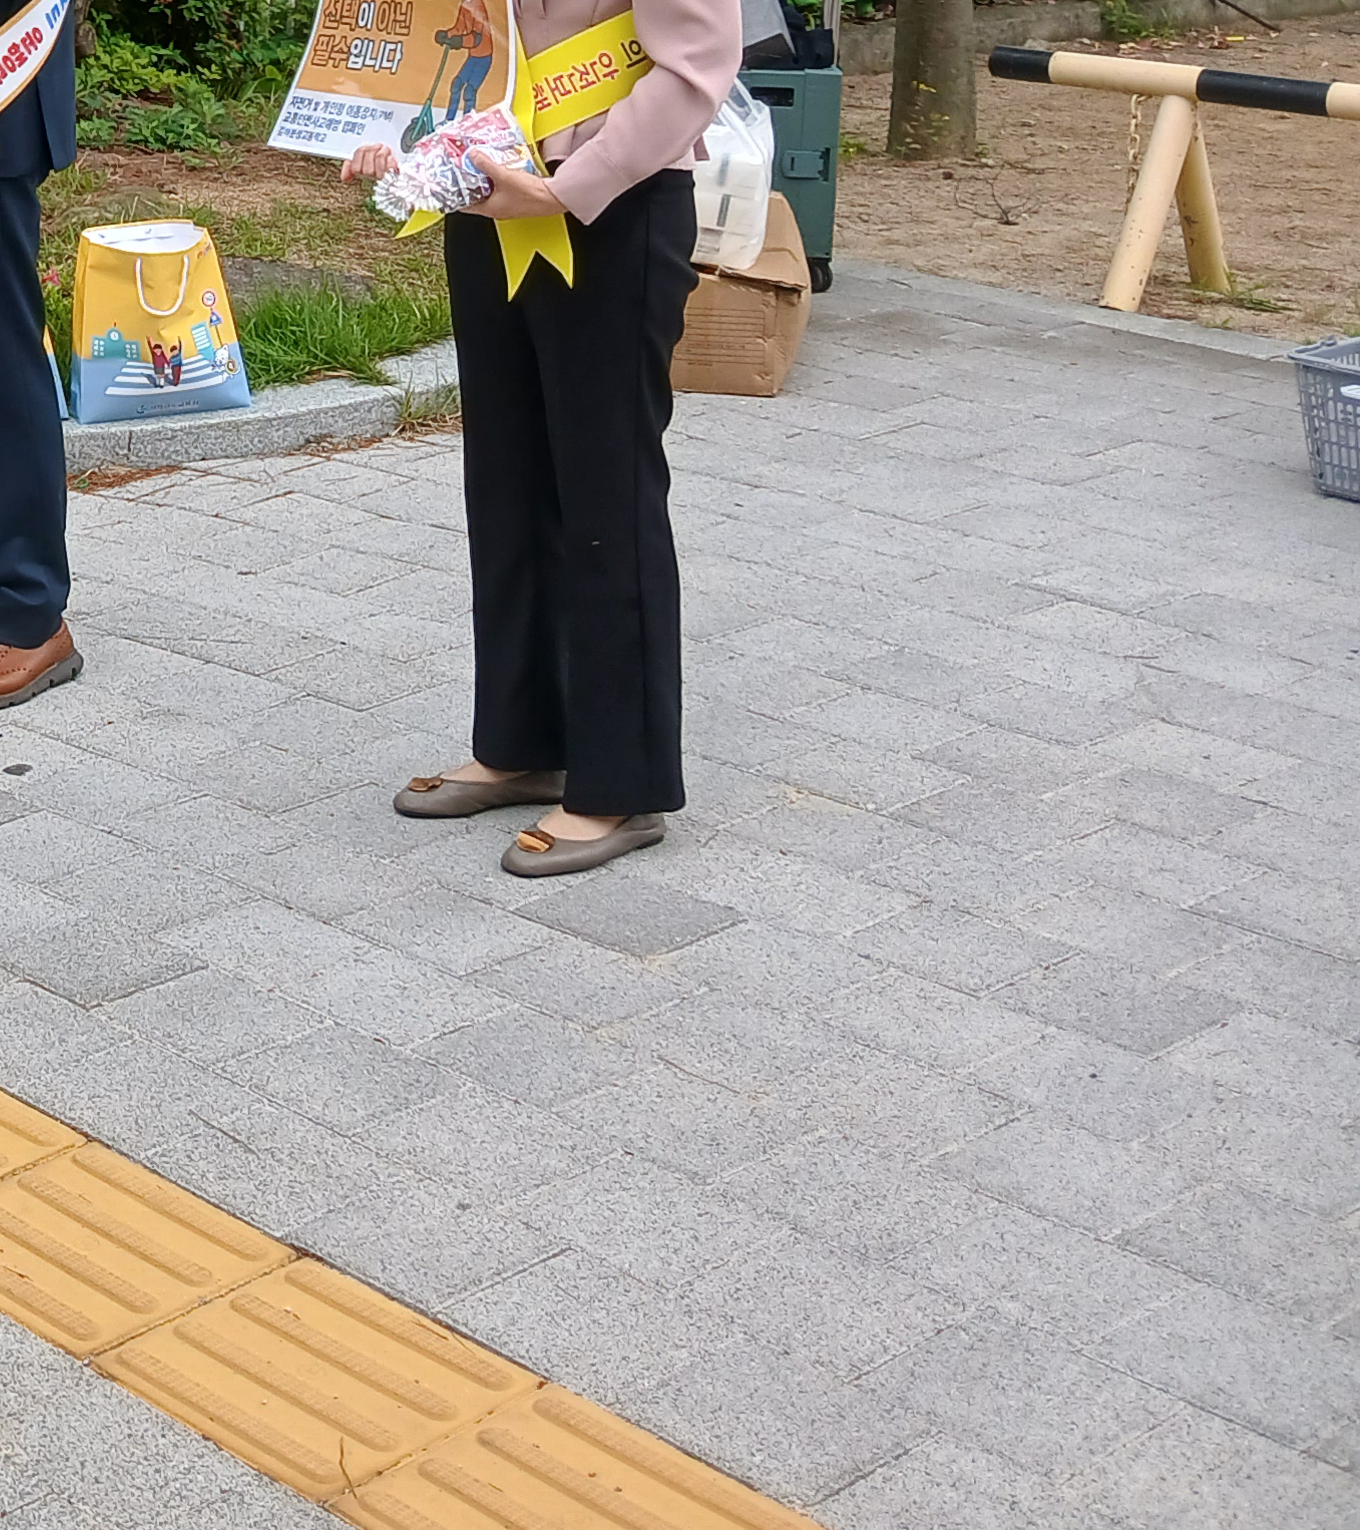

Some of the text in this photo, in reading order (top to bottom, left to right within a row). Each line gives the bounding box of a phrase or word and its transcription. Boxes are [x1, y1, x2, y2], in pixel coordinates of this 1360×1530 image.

[376, 0, 413, 36] 아닌
[311, 34, 403, 74] 필수입니다
[289, 96, 314, 110] 자전거
